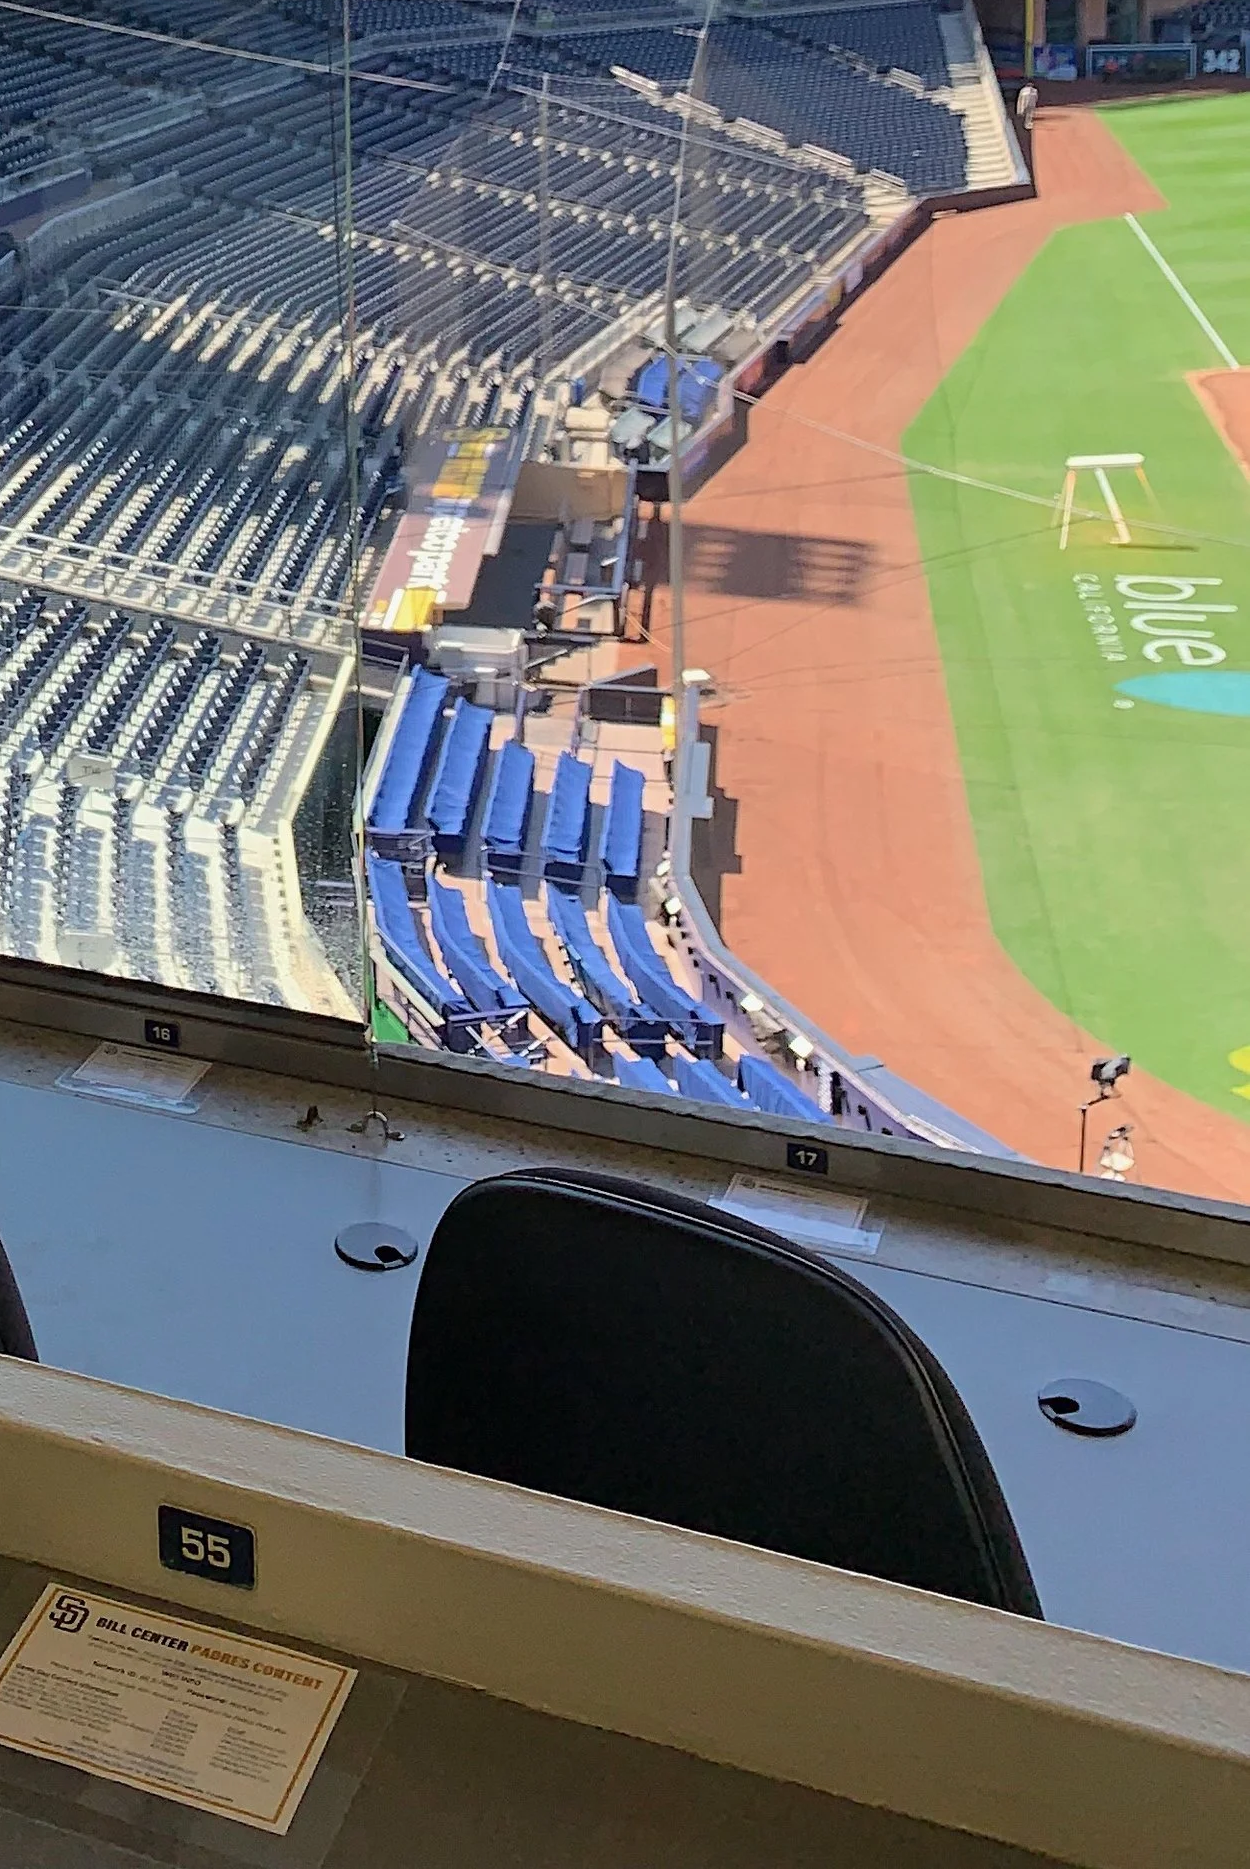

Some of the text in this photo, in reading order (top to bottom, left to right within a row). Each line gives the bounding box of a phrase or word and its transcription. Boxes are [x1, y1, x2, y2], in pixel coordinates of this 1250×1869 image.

[1071, 572, 1129, 662] CALIFORNIA
[1113, 573, 1239, 666] blue
[152, 1025, 172, 1041] 16
[795, 1150, 818, 1166] 17
[180, 1525, 231, 1570] 55
[49, 1594, 325, 1690] SD BILL CENTER PADRES CONTENT
